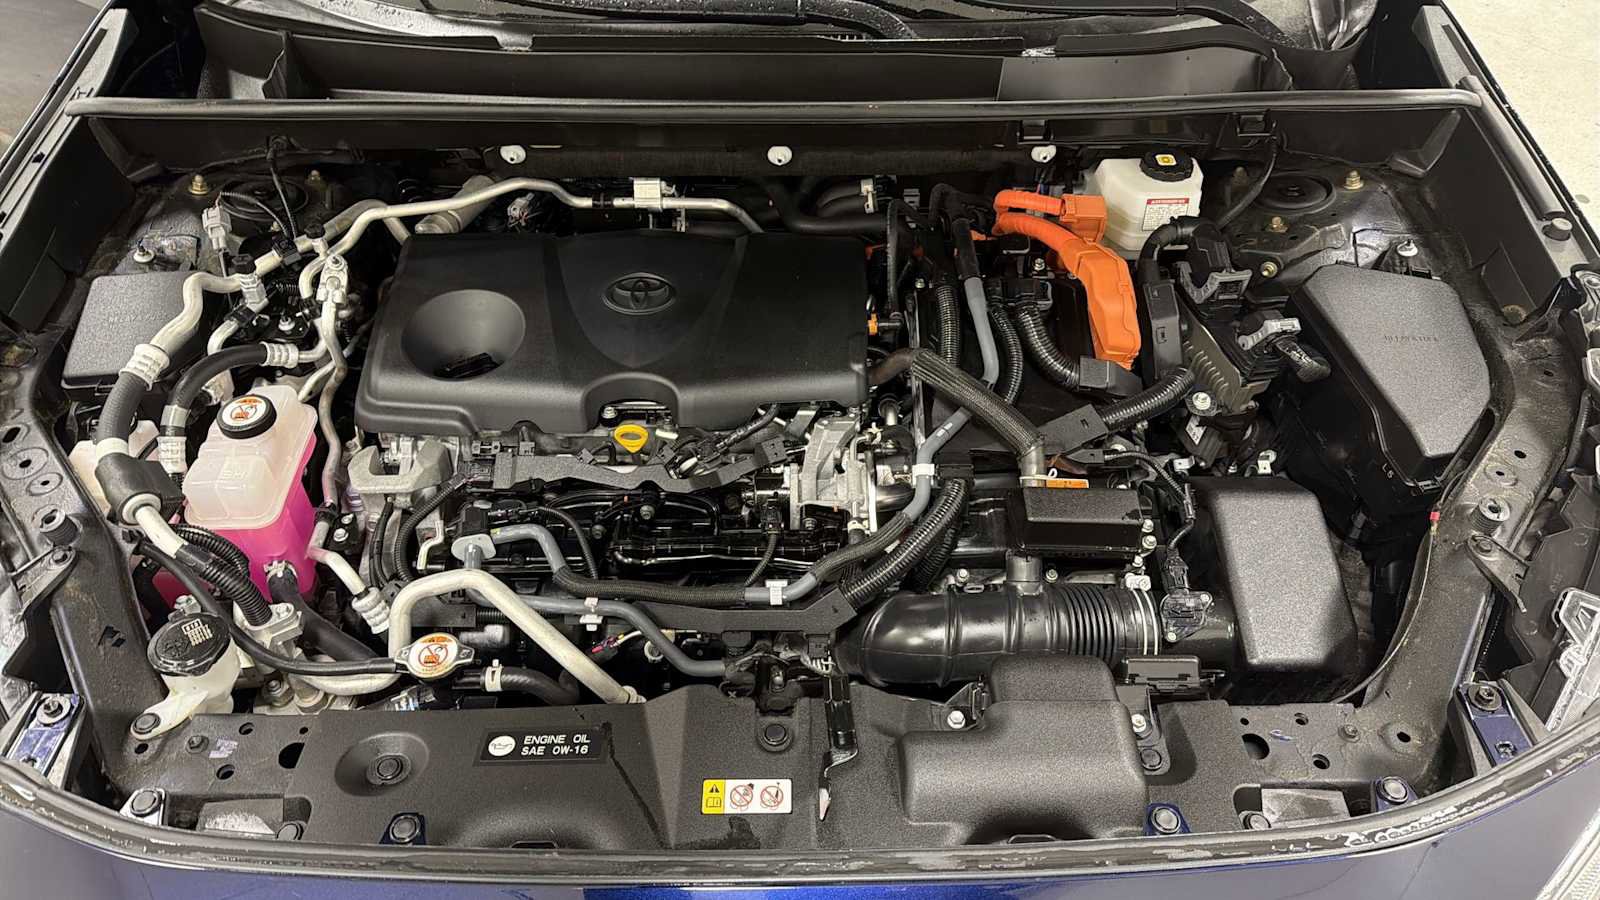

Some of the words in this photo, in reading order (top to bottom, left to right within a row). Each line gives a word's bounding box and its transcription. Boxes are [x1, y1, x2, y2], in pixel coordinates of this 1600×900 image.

[524, 735, 566, 744] ENGINE
[573, 733, 591, 744] OIL
[521, 746, 545, 755] SAE
[552, 745, 588, 754] 0W-16
